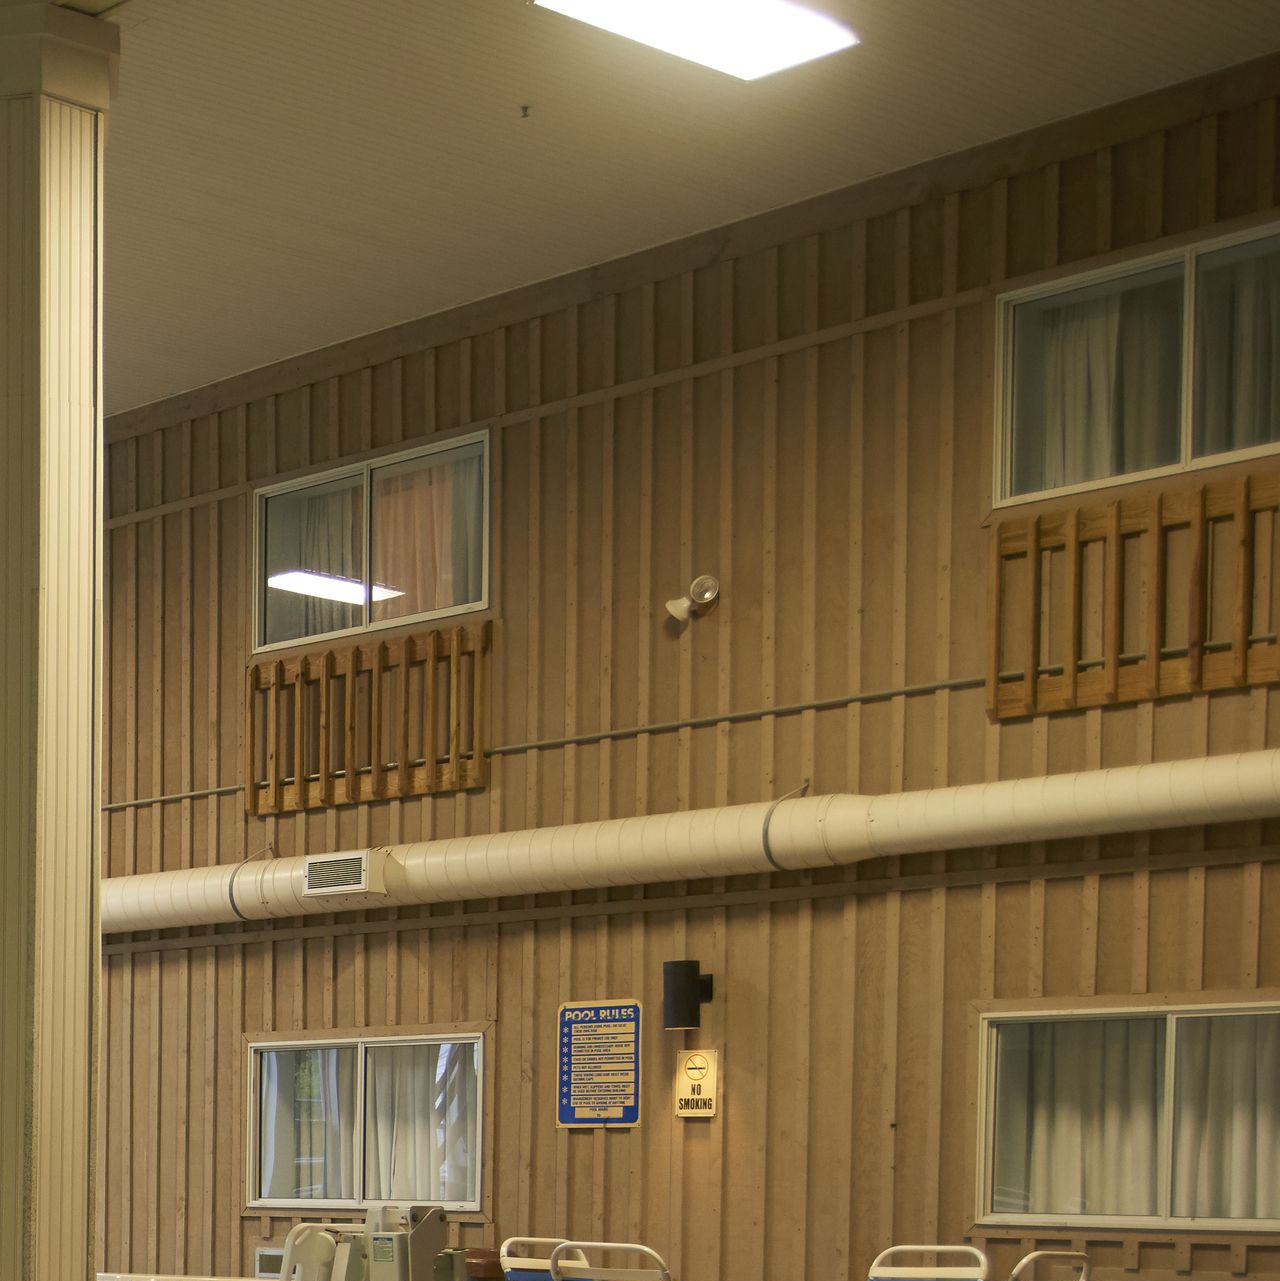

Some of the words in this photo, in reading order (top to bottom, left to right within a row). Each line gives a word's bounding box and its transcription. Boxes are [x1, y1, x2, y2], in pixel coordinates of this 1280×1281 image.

[565, 1010, 597, 1021] POOL
[600, 1008, 634, 1020] RULES
[691, 1084, 702, 1096] NO
[678, 1098, 713, 1110] SMOKING
